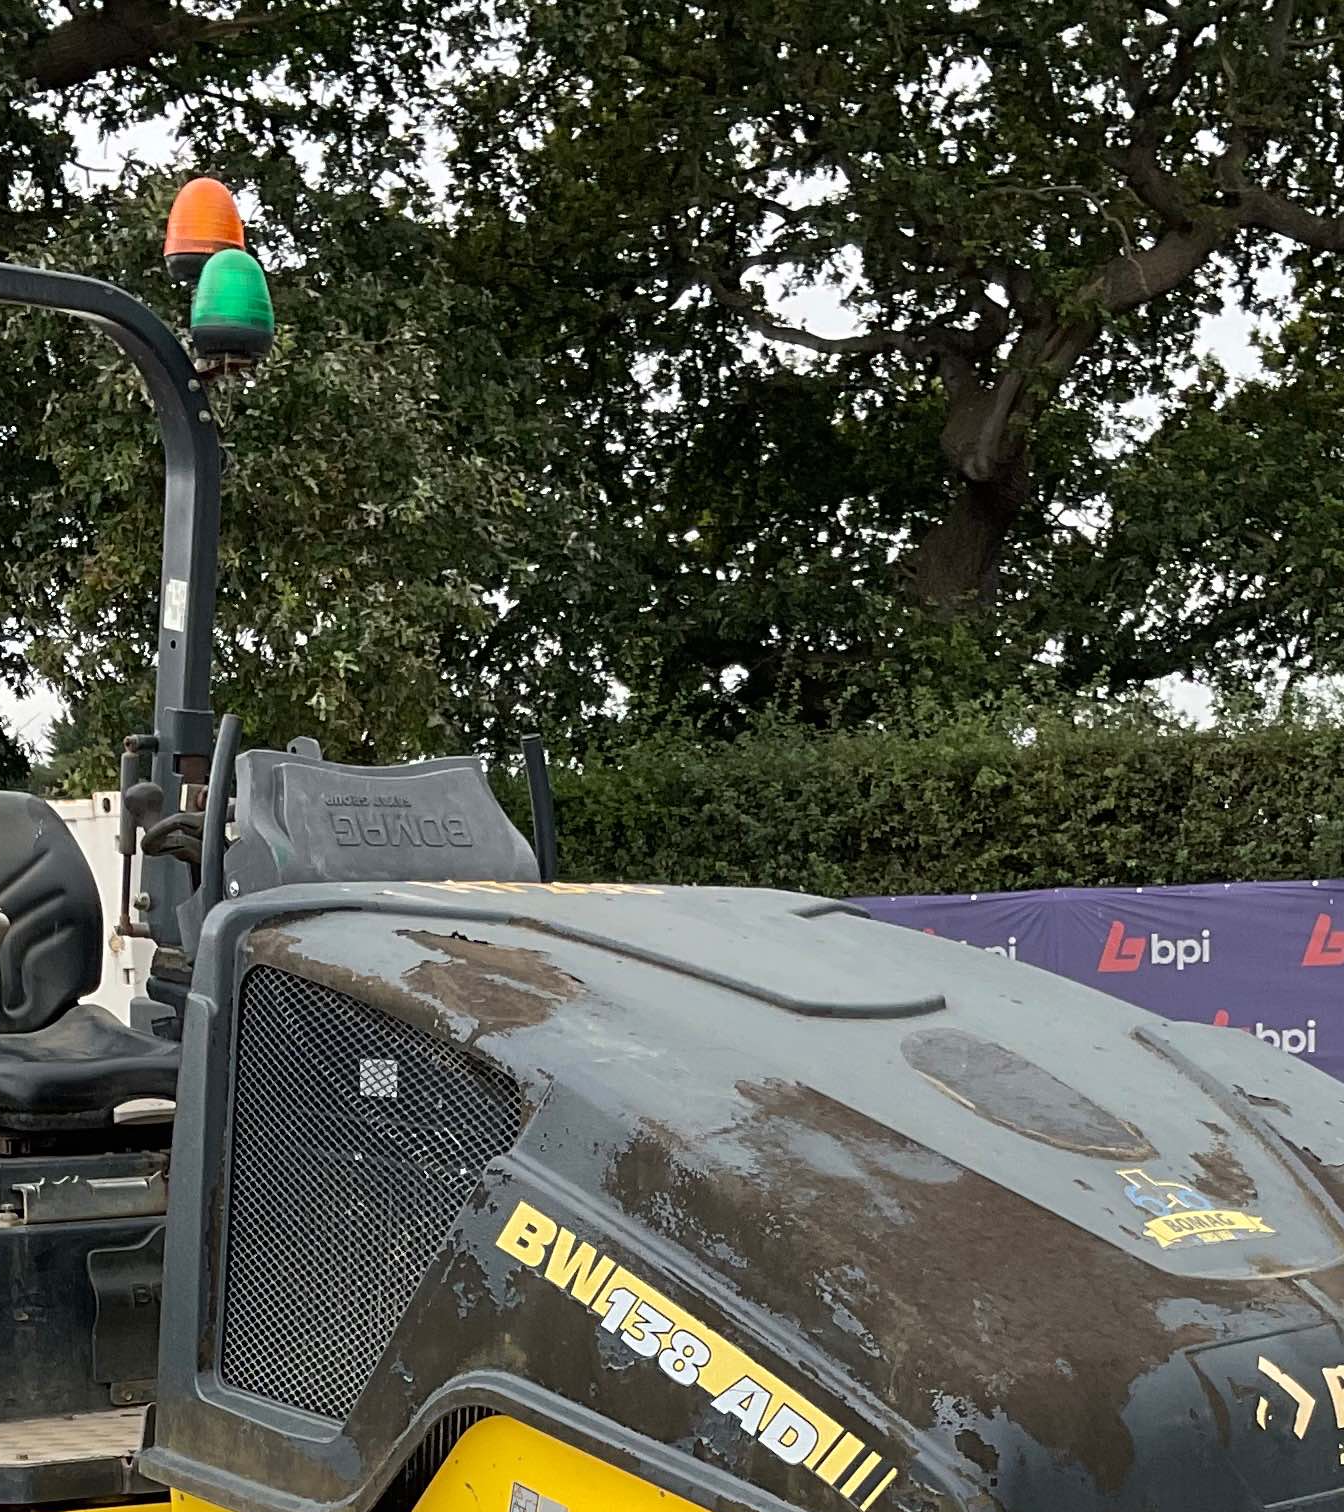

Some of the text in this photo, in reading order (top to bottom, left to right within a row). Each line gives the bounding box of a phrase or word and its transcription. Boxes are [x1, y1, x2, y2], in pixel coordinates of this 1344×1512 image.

[327, 810, 473, 848] BOMAG
[1152, 929, 1209, 970] bpi
[1161, 1213, 1235, 1233] BOMAG
